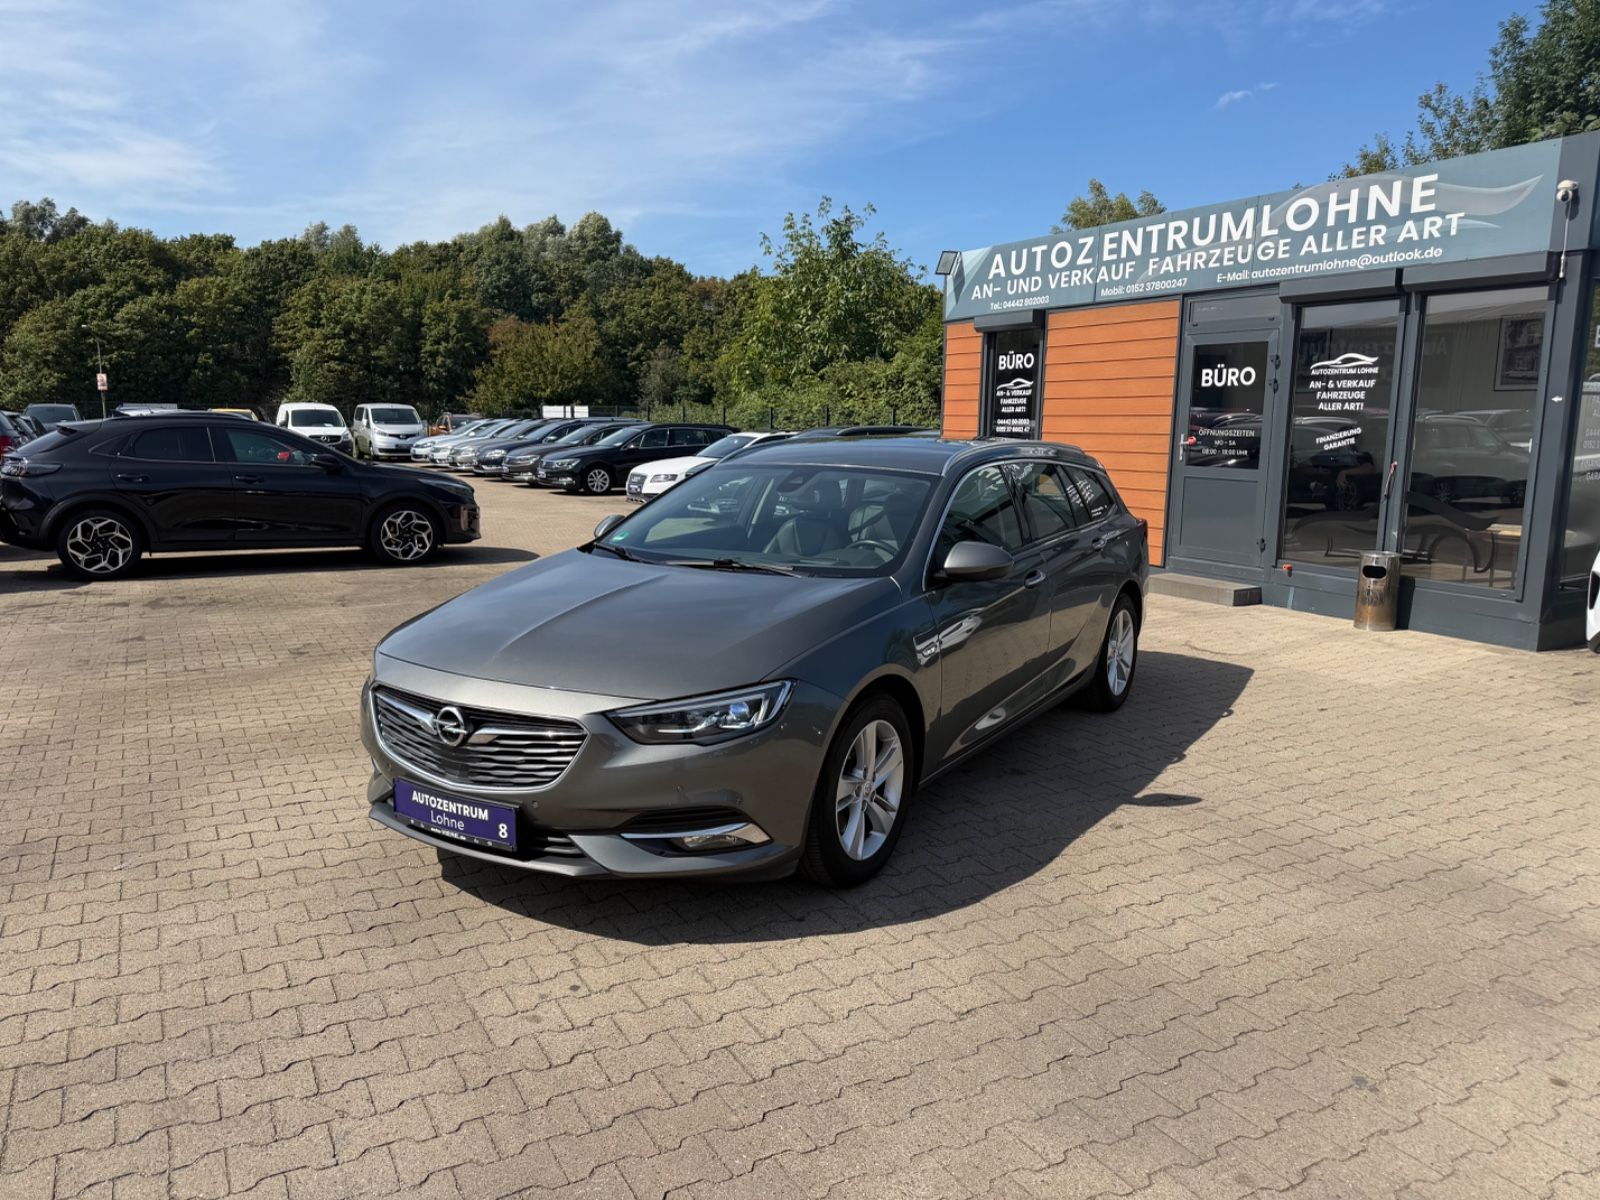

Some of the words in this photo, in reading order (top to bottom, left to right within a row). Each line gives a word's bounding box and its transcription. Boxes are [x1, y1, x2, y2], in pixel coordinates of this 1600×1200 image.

[971, 283, 1002, 301] AN-
[1007, 276, 1042, 296] UND
[1049, 260, 1136, 288] VERKAUF
[1148, 237, 1292, 276] FAHRZEUGE
[1299, 223, 1387, 258] ALLER
[1397, 212, 1465, 245] ART
[1251, 247, 1443, 278] autozentrumlohne@outlook.de
[1101, 285, 1125, 297] Mobil:
[1126, 281, 1145, 294] 0152
[1145, 277, 1188, 291] 37800247
[998, 351, 1034, 370] BÜRO
[1201, 364, 1256, 386] BÜRO
[1309, 380, 1326, 389] AN-
[1327, 380, 1335, 388] &
[1336, 379, 1377, 389] VERKAUF
[1316, 390, 1366, 400] FAHRZEUGE
[1318, 402, 1342, 411] ALLER
[1198, 427, 1255, 437] ÖFFNUNGSZEITEN
[1316, 427, 1362, 444] FINANZIERUNG
[1324, 437, 1355, 450] GARANTIE
[411, 790, 489, 821] AUTOZENTRUM
[430, 810, 465, 831] Lohne
[498, 823, 508, 839] 8
